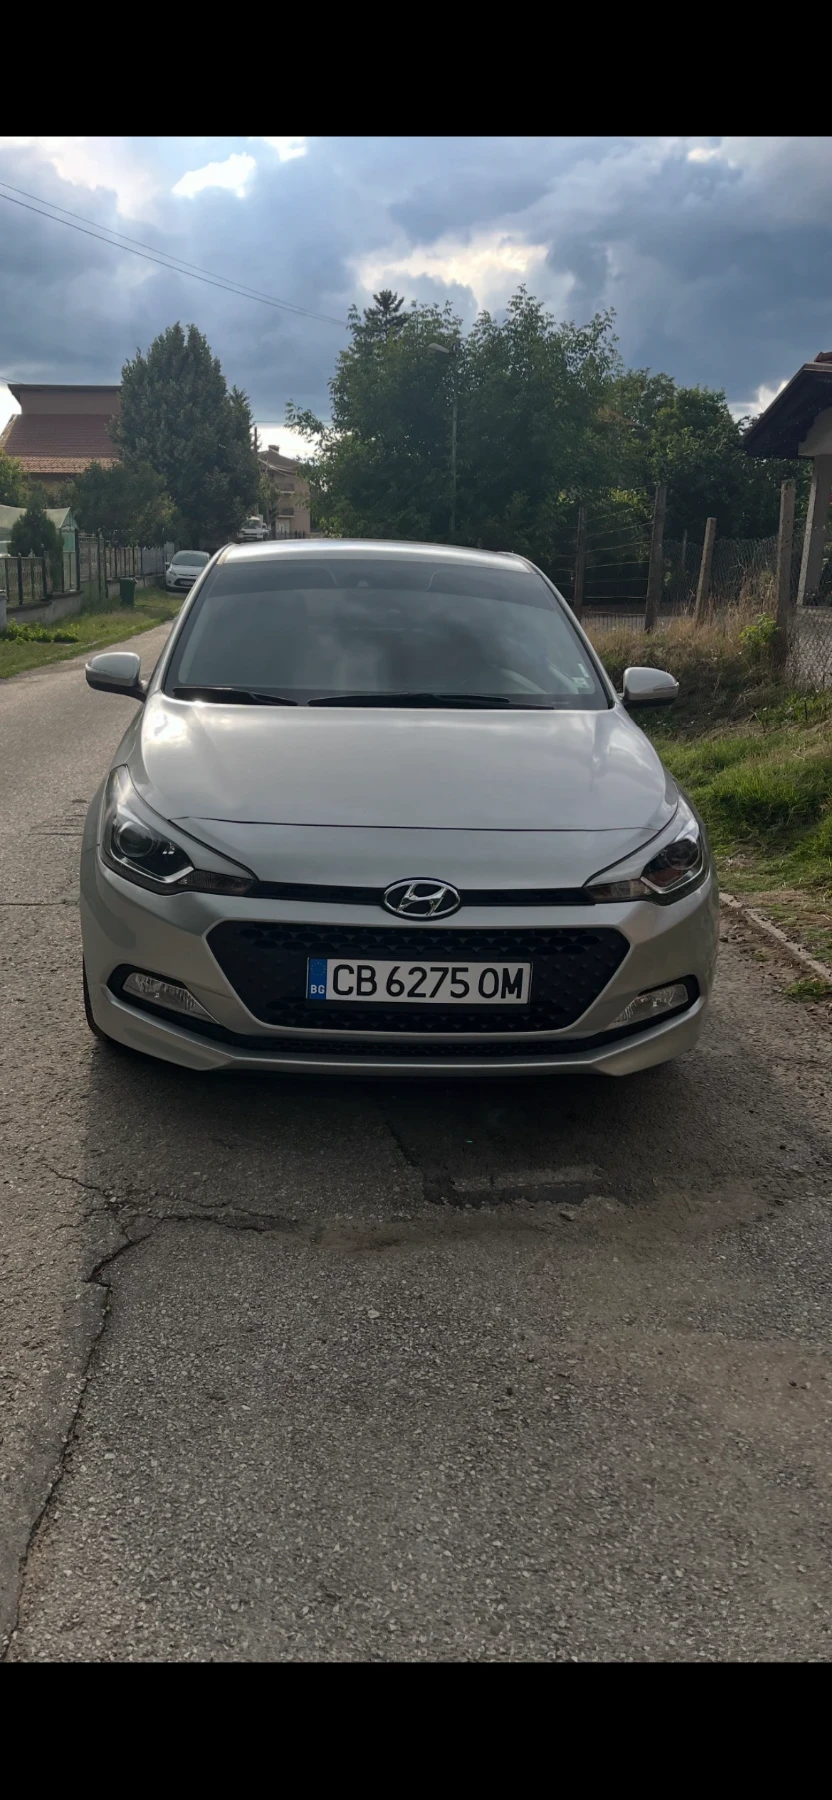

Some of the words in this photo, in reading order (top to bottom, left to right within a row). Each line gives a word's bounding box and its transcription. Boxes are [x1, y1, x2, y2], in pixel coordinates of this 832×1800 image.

[310, 985, 325, 995] BG
[333, 964, 378, 996] CB
[386, 966, 470, 998] 6275
[478, 968, 524, 999] OM
